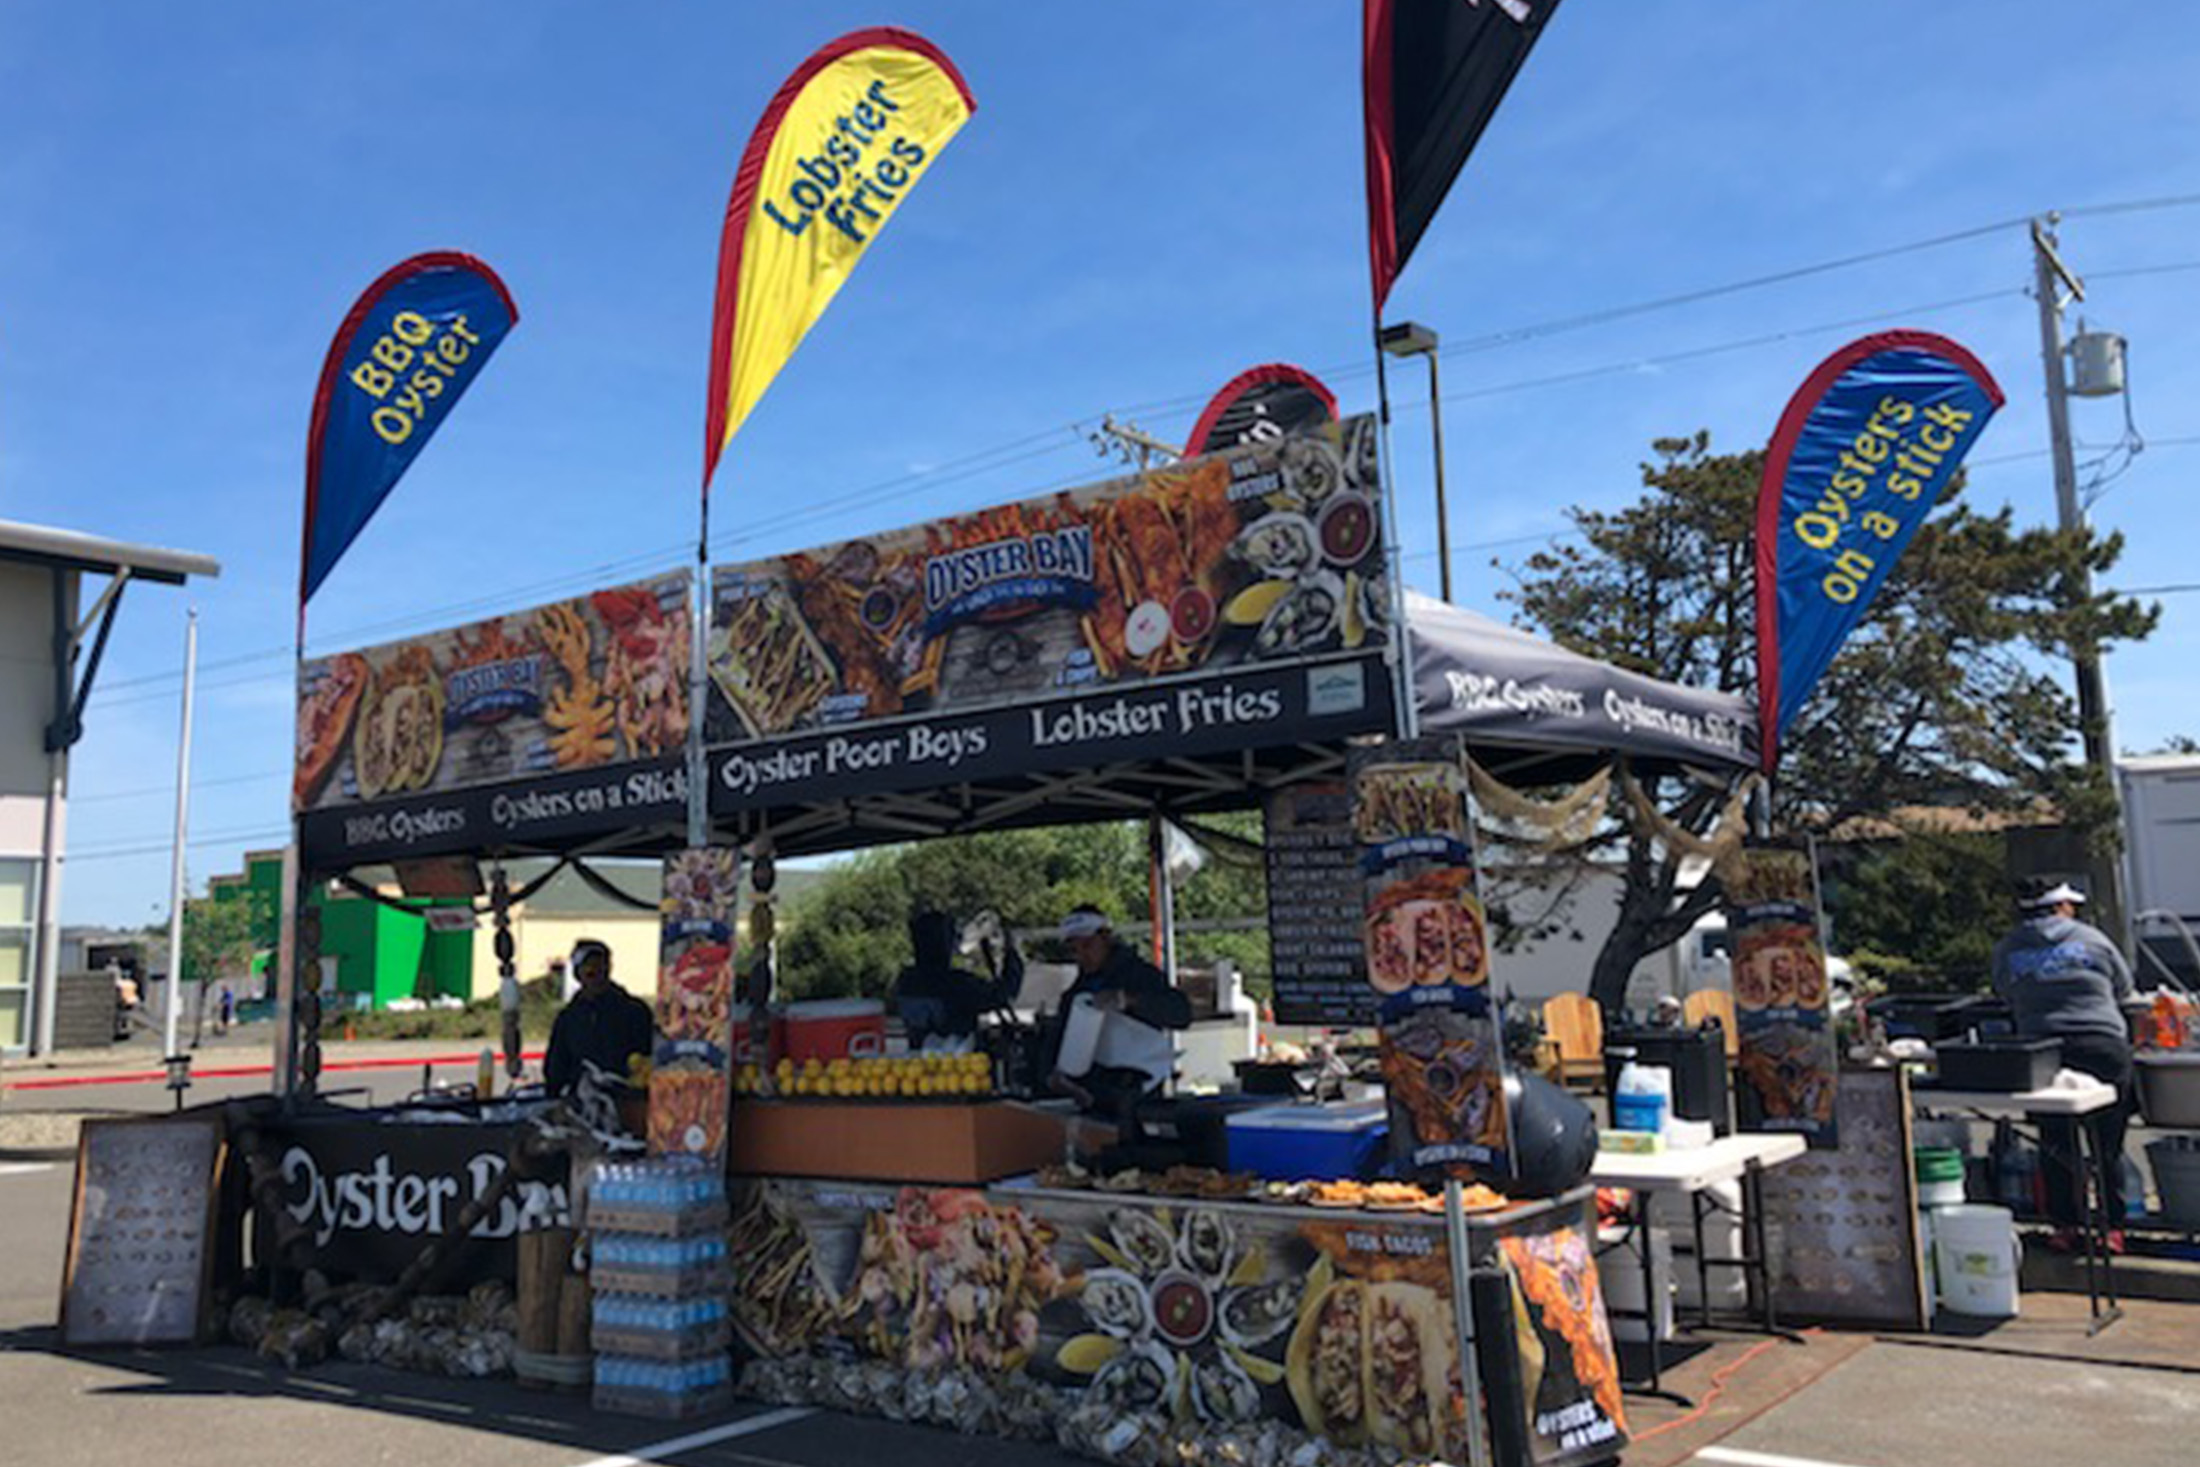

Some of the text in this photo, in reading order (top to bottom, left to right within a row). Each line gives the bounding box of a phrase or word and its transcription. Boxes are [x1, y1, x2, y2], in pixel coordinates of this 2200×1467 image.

[763, 80, 898, 236] Lobster
[352, 310, 434, 399] BBQ
[371, 315, 479, 444] Oyster
[1794, 396, 1915, 549] Oysters
[1823, 403, 1973, 604] on a stick
[926, 539, 1031, 610] OYSTER
[1033, 525, 1094, 581] BAY
[1032, 686, 1282, 746] Lobster Fries
[722, 724, 987, 794] Oyster Poor Boys
[390, 805, 466, 844] Oysters
[492, 791, 573, 829] Oysters
[576, 788, 605, 812] on
[607, 786, 623, 809] a
[1345, 1231, 1433, 1255] FISH TACOS
